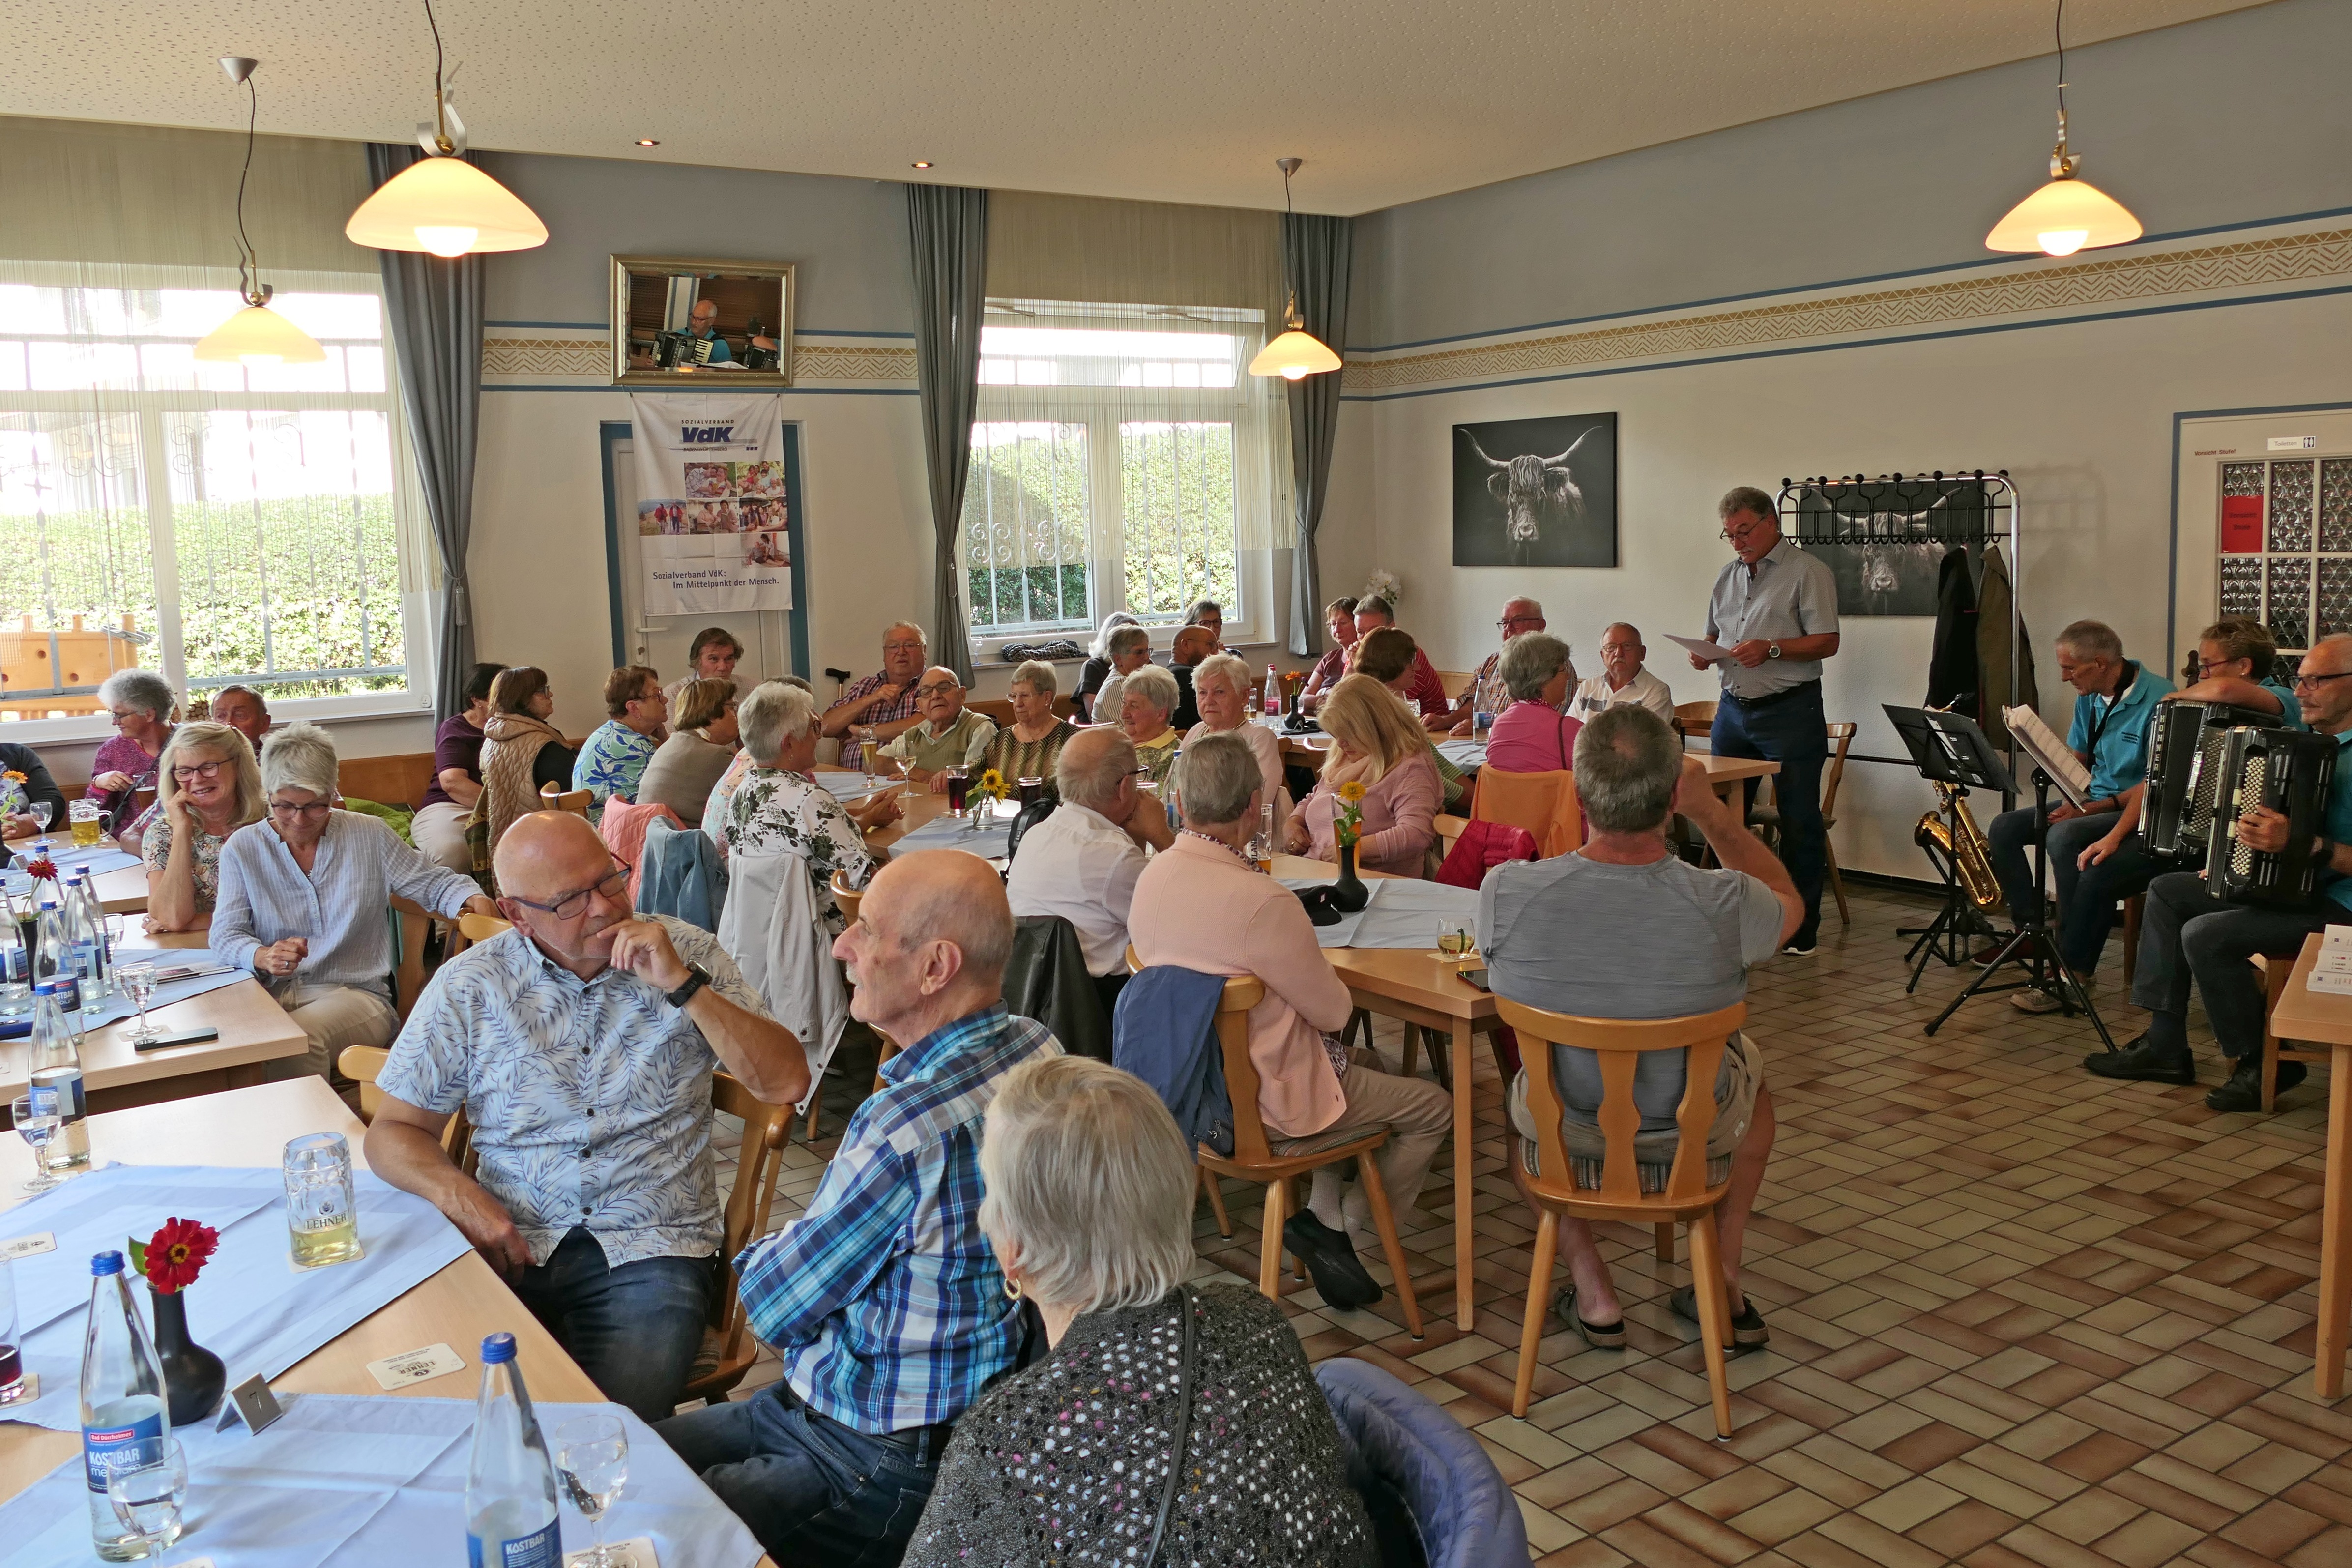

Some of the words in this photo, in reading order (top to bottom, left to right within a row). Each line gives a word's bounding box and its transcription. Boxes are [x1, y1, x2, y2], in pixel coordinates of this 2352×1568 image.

[682, 427, 734, 443] VdK
[653, 570, 706, 580] Sozialverband
[686, 579, 732, 589] Mittelpunkt
[2154, 715, 2165, 771] HOHNER
[57, 990, 74, 1000] STBAR
[306, 1213, 347, 1229] LEHNER
[399, 1361, 436, 1374] LEHNER
[100, 1431, 132, 1441] Dürrheimer
[89, 1447, 140, 1466] KOSTBAR
[506, 1533, 545, 1555] KOSTBAR
